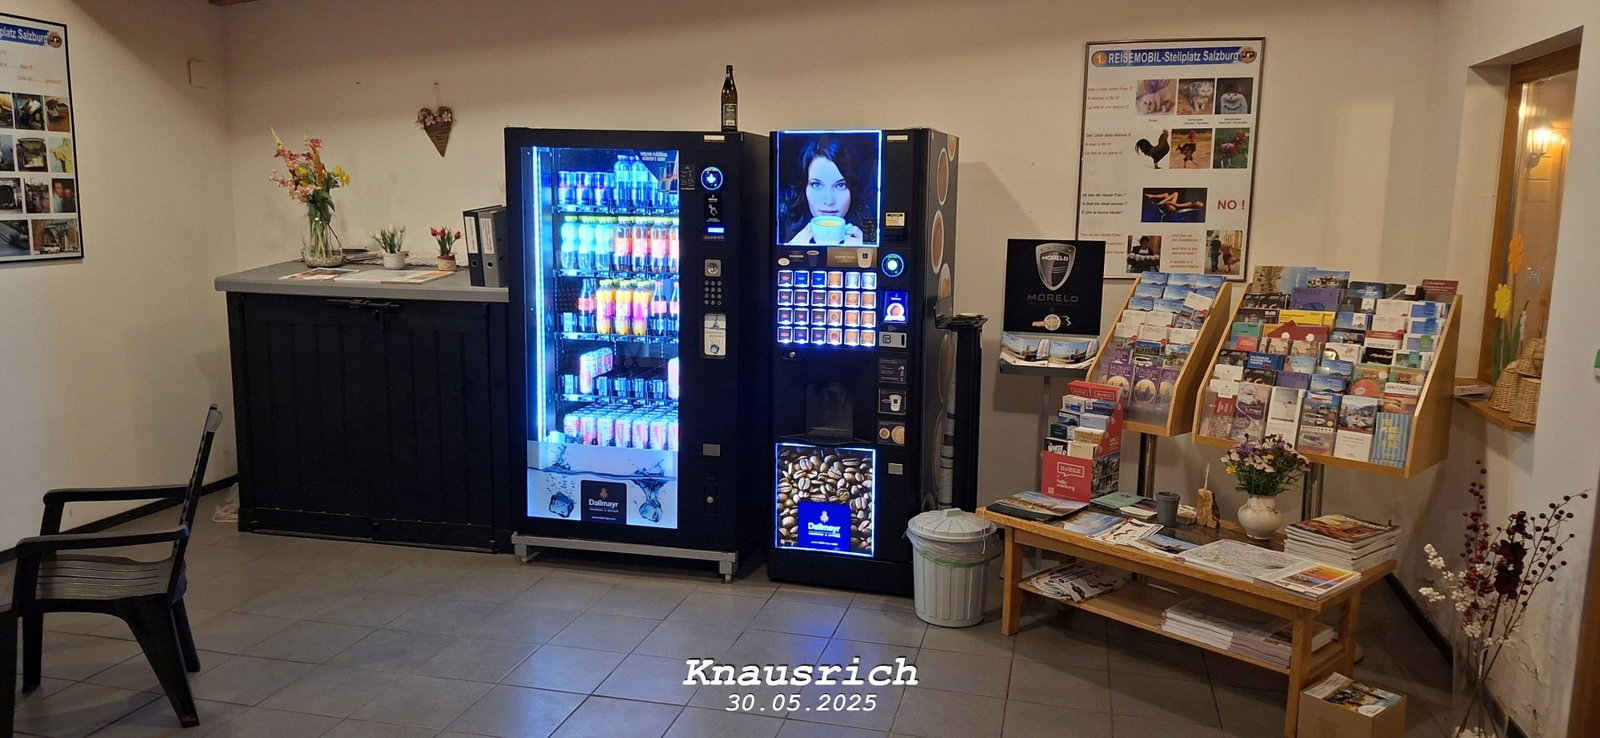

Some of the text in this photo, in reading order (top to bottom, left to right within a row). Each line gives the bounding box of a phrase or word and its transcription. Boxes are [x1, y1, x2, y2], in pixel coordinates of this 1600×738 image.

[18, 28, 48, 46] Salzburg
[1108, 51, 1201, 64] REISEMOBIL-Stellplatz
[1202, 49, 1239, 62] Salzburg
[1217, 199, 1245, 210] NO !
[1041, 254, 1069, 262] MORELO
[1027, 293, 1079, 303] MORELO
[588, 498, 619, 509] Dallmayr
[807, 521, 841, 534] Dallmayr
